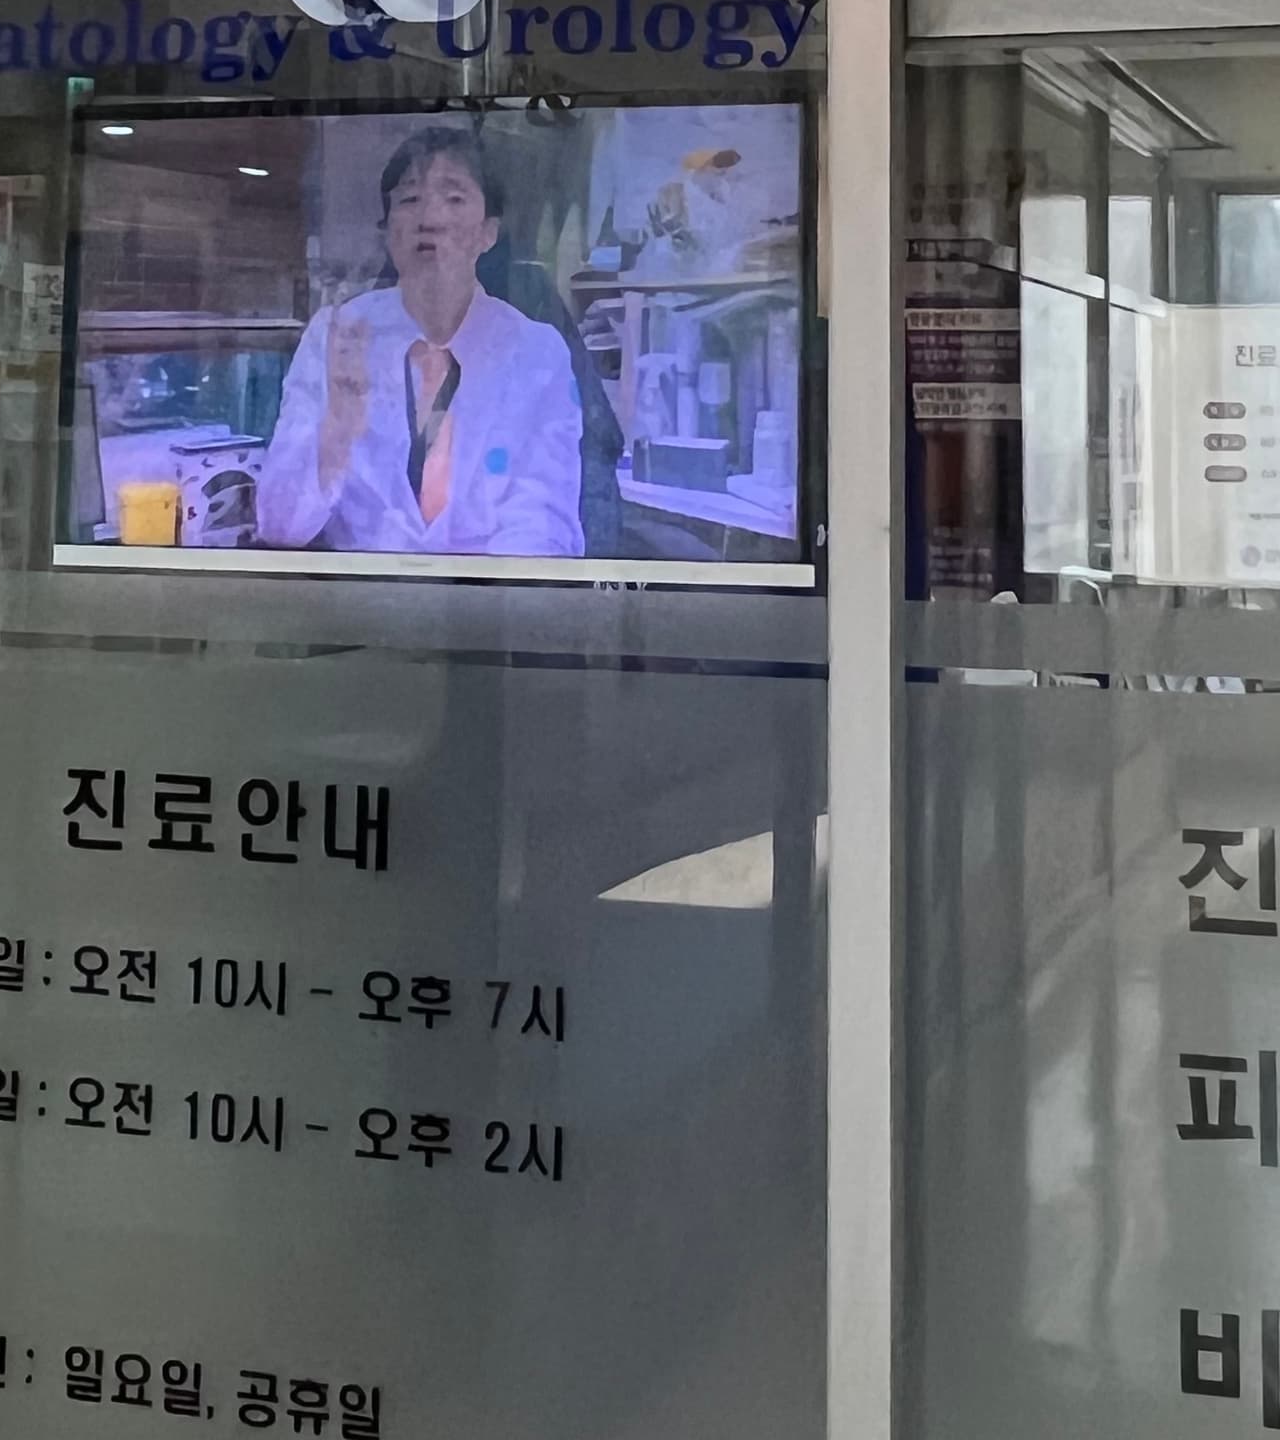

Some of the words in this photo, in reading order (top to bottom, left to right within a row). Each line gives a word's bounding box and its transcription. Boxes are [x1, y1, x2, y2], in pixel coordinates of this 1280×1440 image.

[329, 1, 396, 64] &
[62, 768, 392, 872] 진료안내
[70, 945, 158, 1004] 오전
[187, 955, 288, 1016] 10시
[358, 970, 453, 1030] 오후
[64, 1076, 154, 1137] 오전
[184, 1090, 285, 1152] 10시
[355, 1106, 453, 1169] 오후
[484, 1120, 564, 1182] 2시
[237, 1370, 383, 1440] 공휴일
